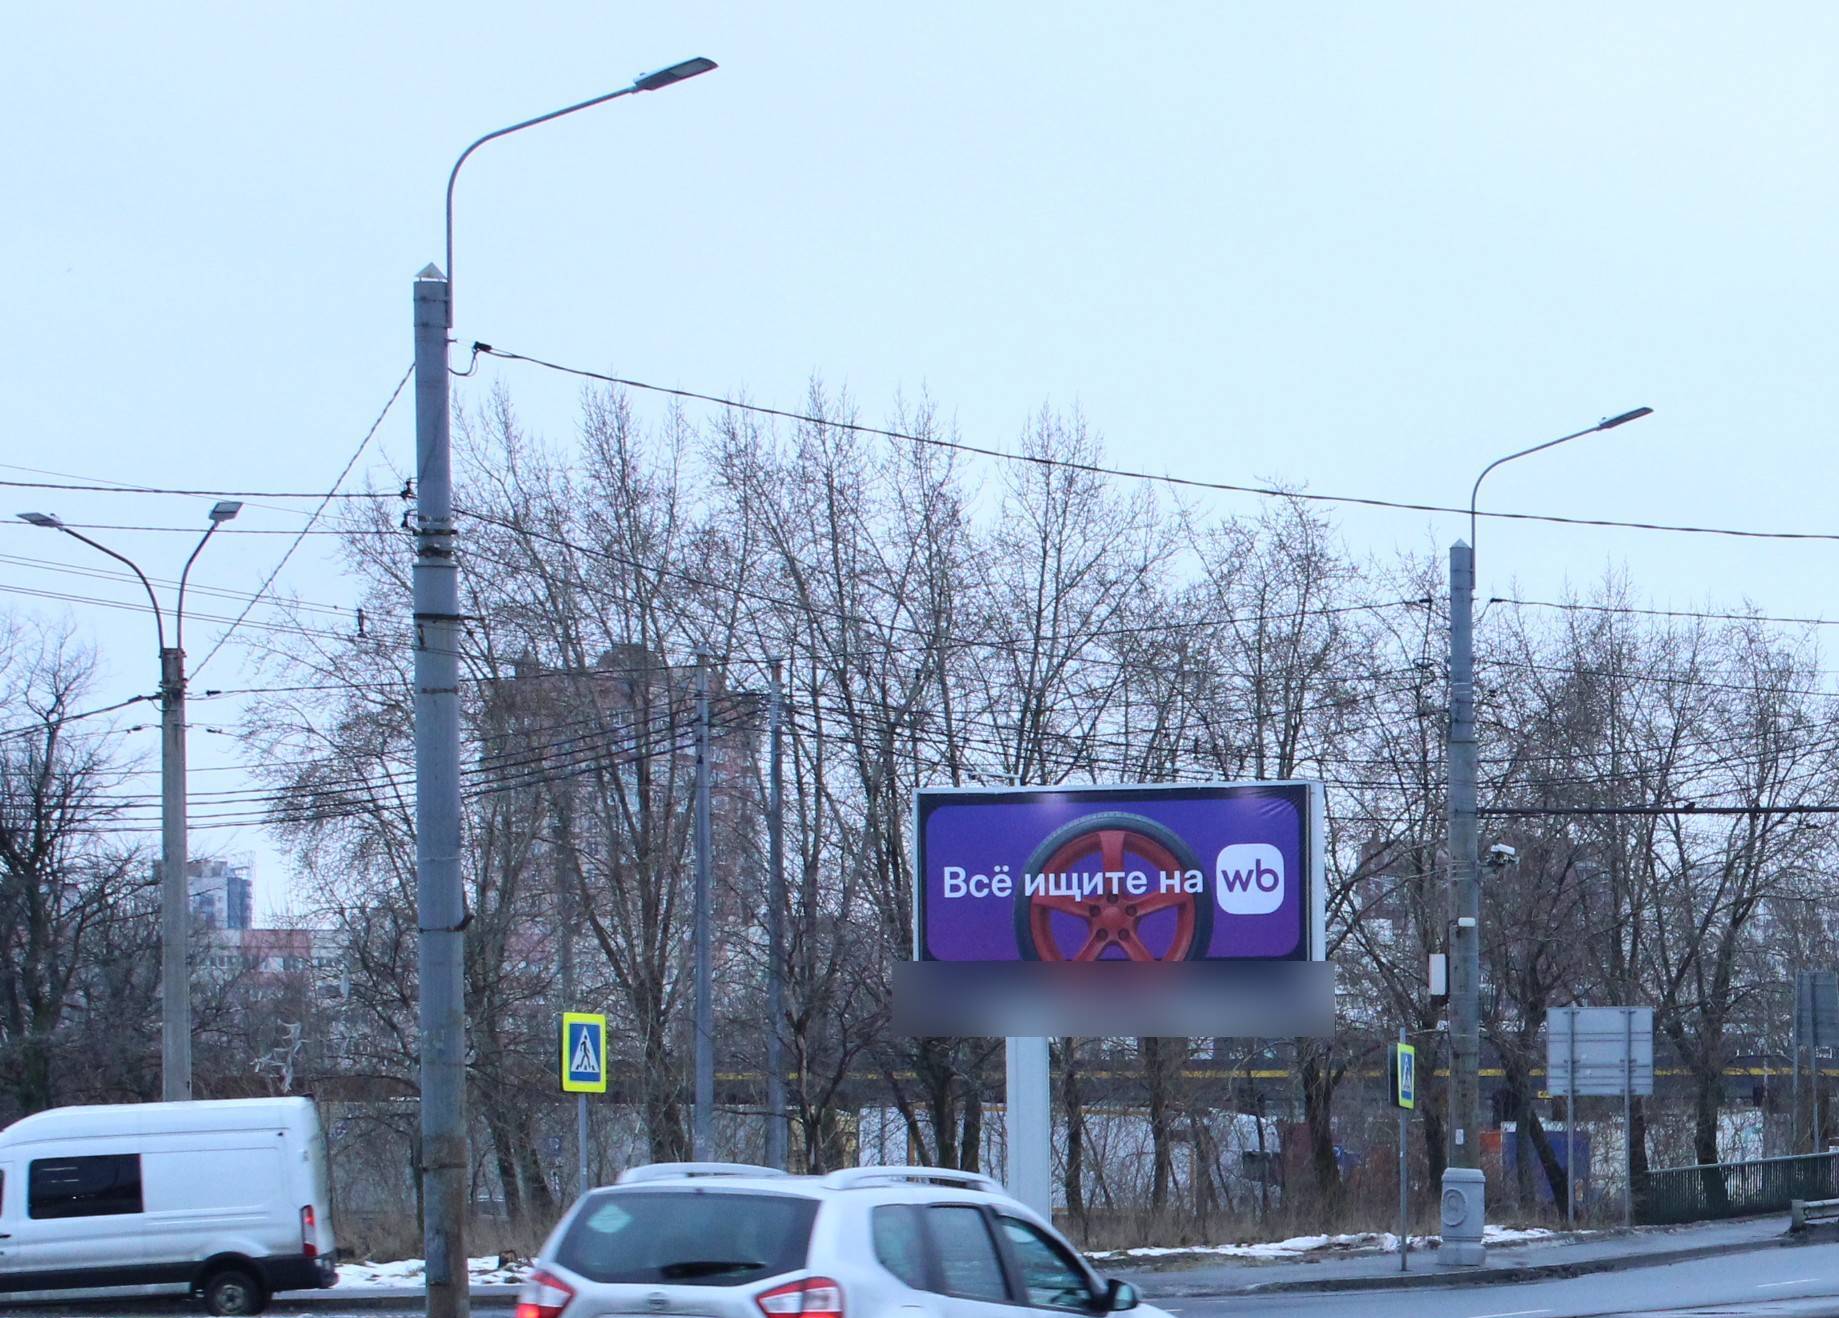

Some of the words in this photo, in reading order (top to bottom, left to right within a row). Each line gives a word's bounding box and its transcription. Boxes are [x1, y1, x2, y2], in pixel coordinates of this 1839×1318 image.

[943, 865, 1012, 898] Всё
[1024, 869, 1147, 902] ищите
[1159, 869, 1204, 894] на
[1221, 858, 1279, 893] wb
